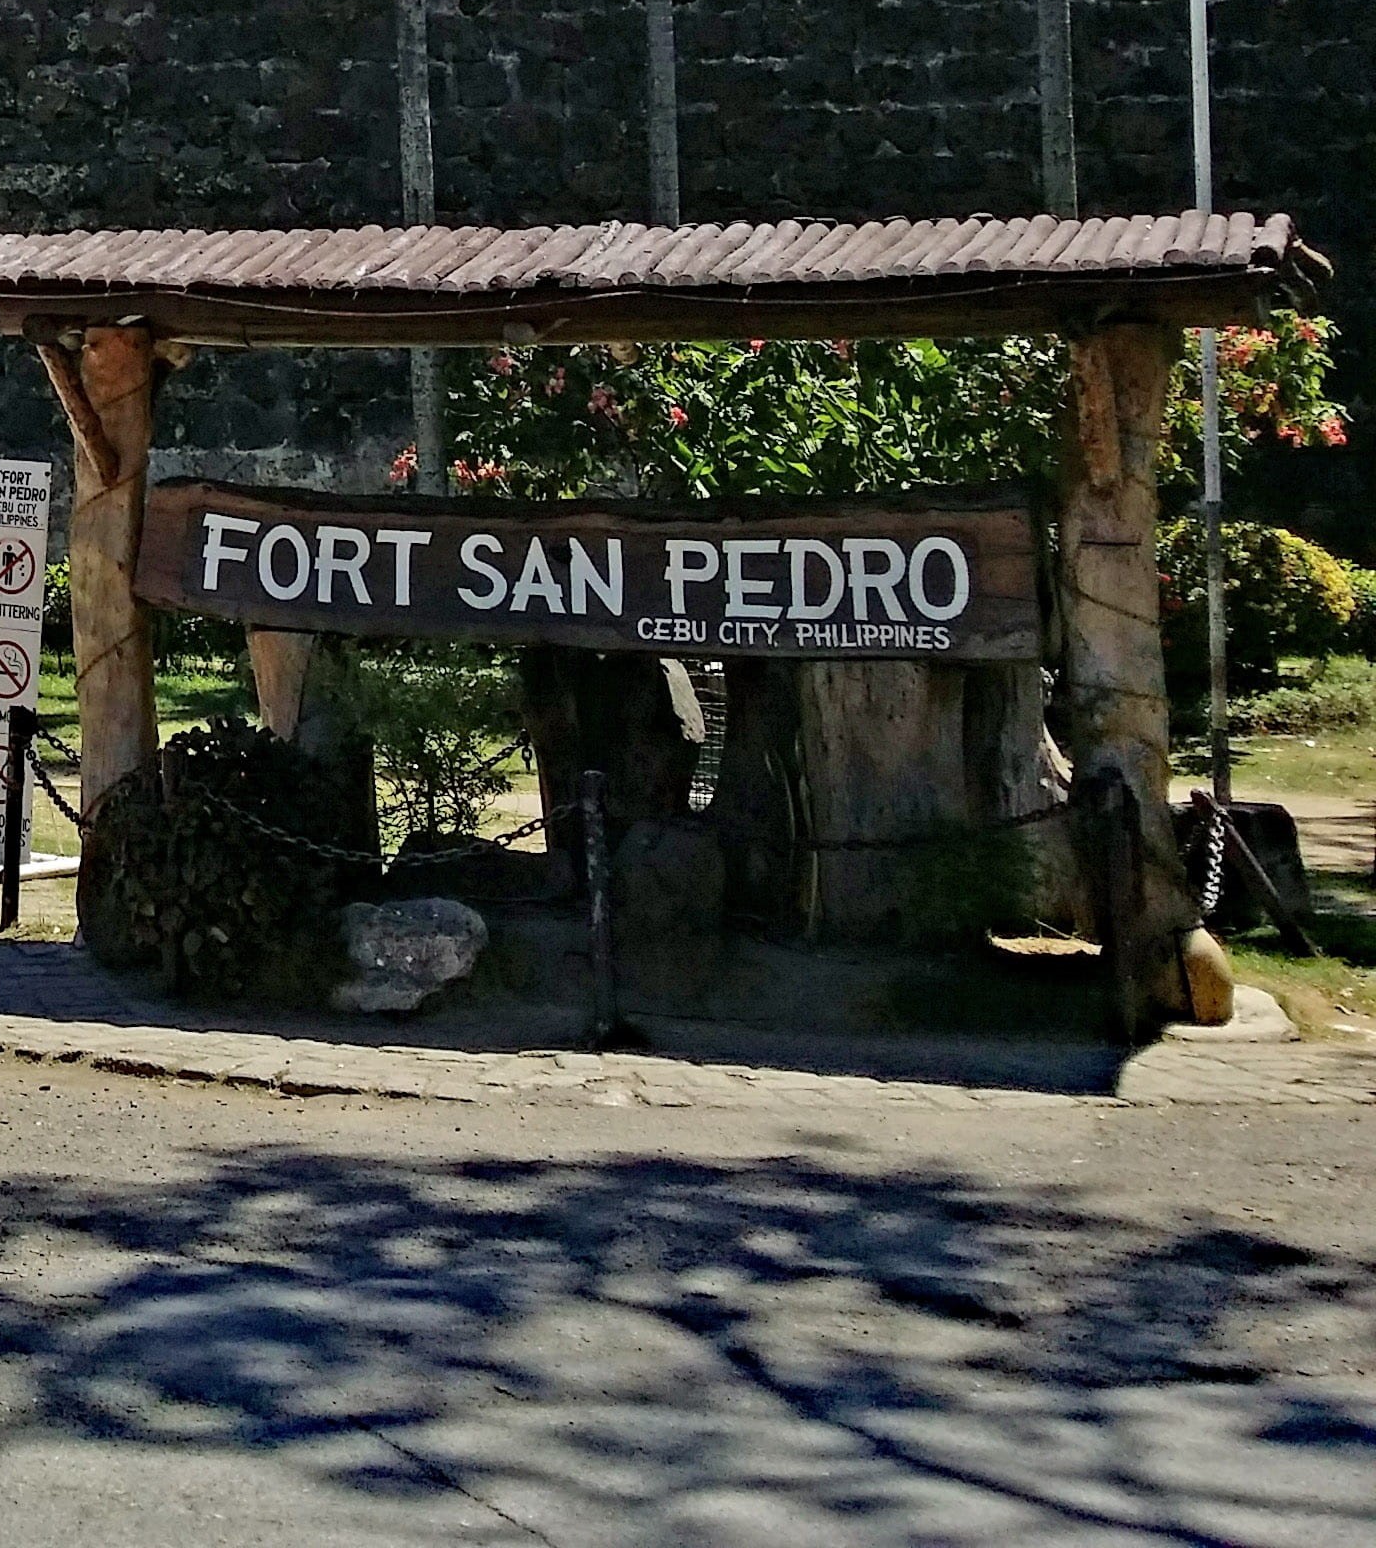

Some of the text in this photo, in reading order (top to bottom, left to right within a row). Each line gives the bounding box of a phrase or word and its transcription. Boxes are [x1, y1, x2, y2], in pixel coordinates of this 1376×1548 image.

[0, 470, 32, 485] FORT
[9, 486, 47, 502] PEDRO
[17, 503, 37, 514] CITY
[202, 512, 970, 621] FORT SAN PEDRO
[637, 617, 707, 642] CEBU
[796, 623, 950, 650] PHILIPPINES
